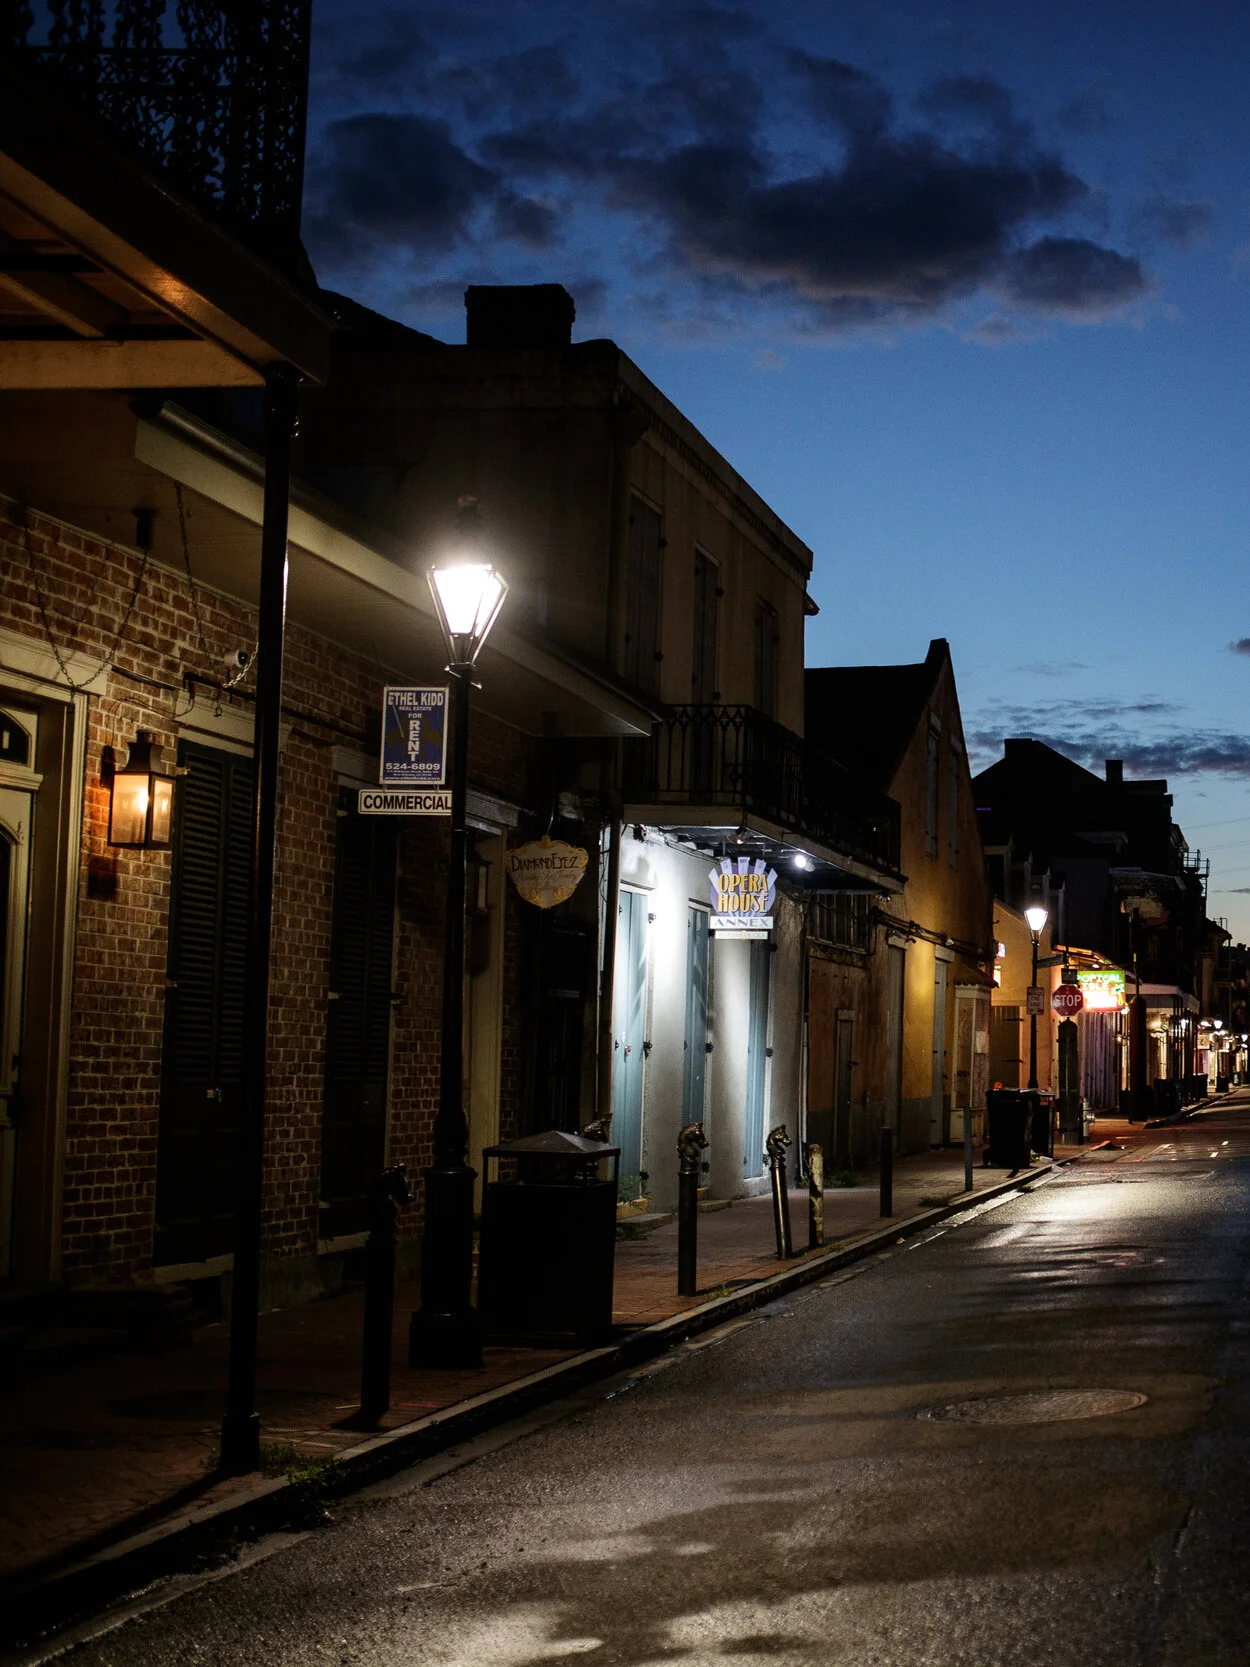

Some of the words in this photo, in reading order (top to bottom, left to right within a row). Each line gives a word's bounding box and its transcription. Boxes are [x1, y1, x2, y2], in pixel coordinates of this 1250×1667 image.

[388, 692, 418, 706] ETHEL
[421, 692, 444, 706] KIDD
[407, 720, 421, 761] RENT
[386, 763, 440, 771] 524-6809
[363, 795, 452, 810] COMMERCIAL
[718, 874, 768, 893] OPERA
[718, 894, 768, 913] HOUSE
[715, 918, 769, 927] ANNEX
[1077, 974, 1122, 983] OPICAL
[1054, 994, 1082, 1007] STOP
